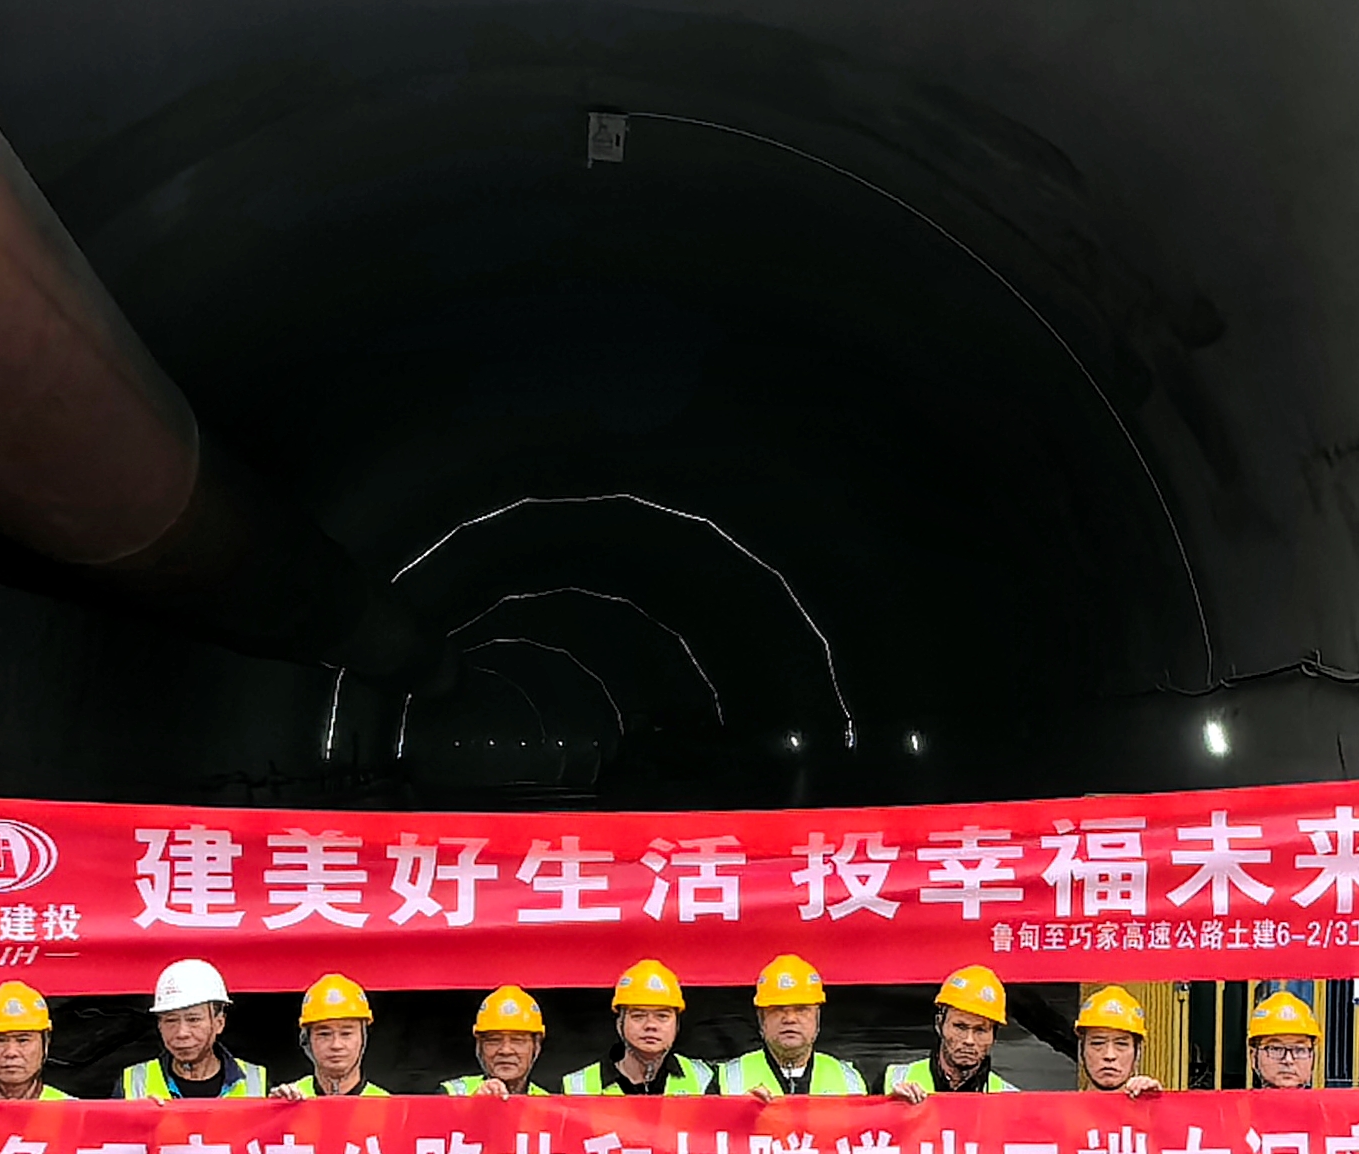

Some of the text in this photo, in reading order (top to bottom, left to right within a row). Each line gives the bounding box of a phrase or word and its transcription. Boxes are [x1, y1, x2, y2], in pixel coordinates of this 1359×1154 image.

[132, 813, 745, 931] 建美好生活
